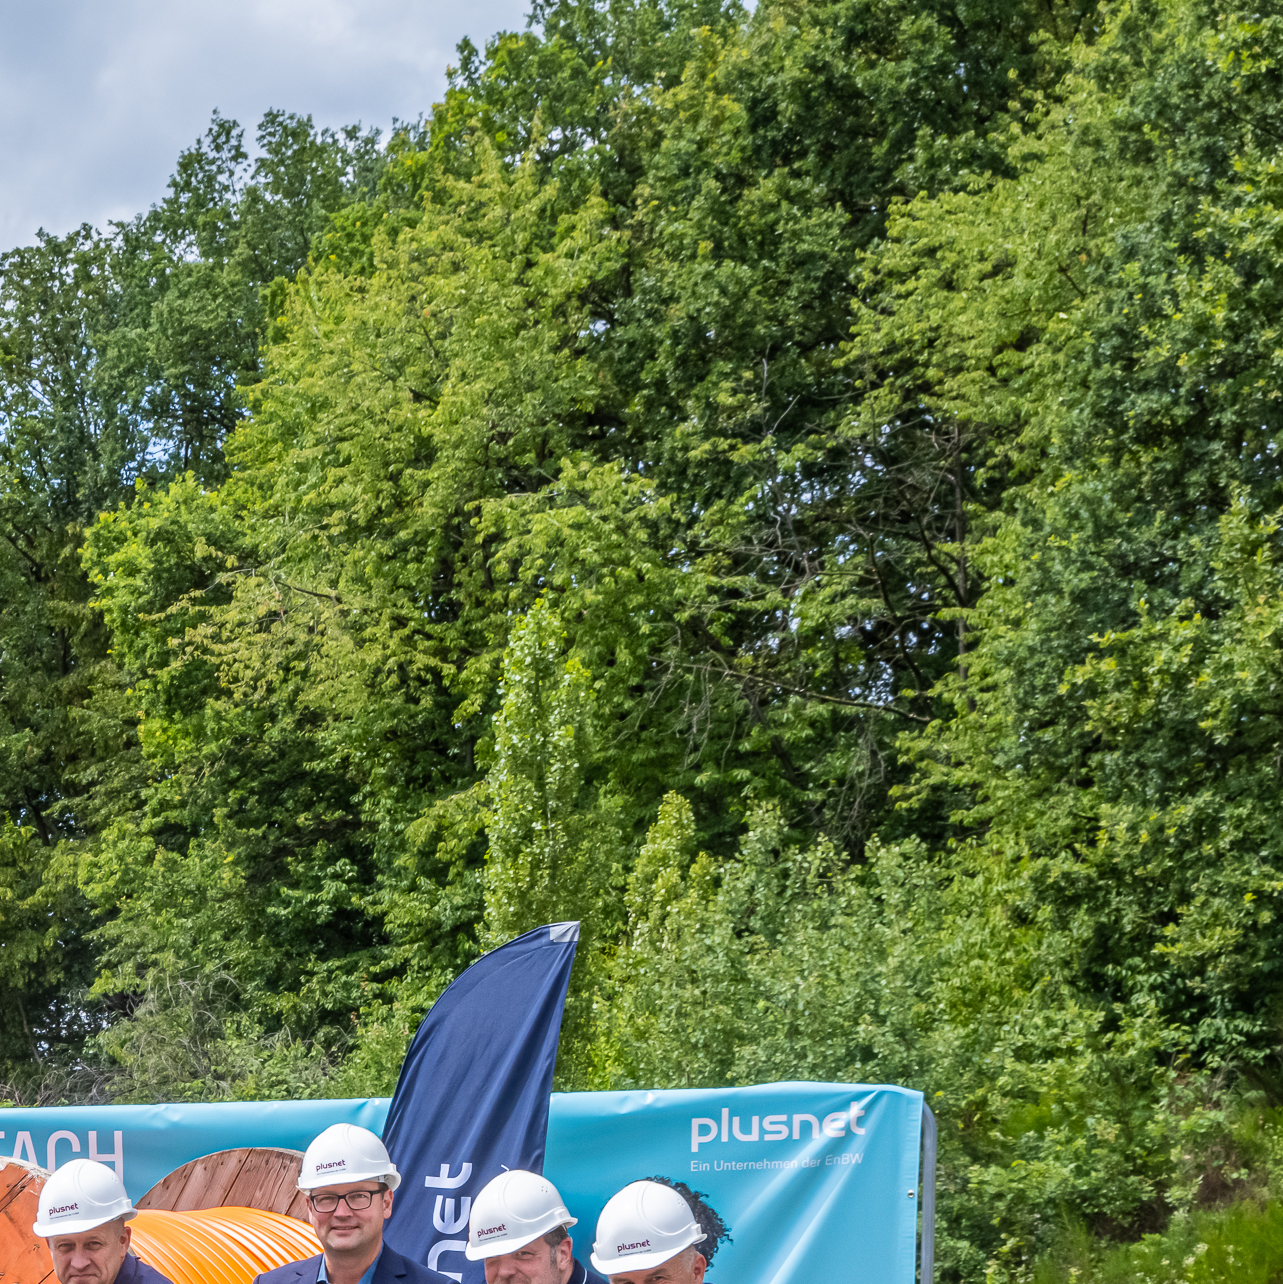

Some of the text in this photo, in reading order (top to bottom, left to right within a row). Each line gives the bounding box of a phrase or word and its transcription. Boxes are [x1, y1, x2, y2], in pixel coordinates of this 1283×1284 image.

[691, 1101, 866, 1153] plusnet
[316, 1159, 345, 1172] plusnet
[690, 1153, 864, 1172] Ein Unternehmen der EnBW
[48, 1203, 78, 1216] plusnet
[477, 1223, 506, 1238] plusnet
[616, 1239, 651, 1253] plusnet
